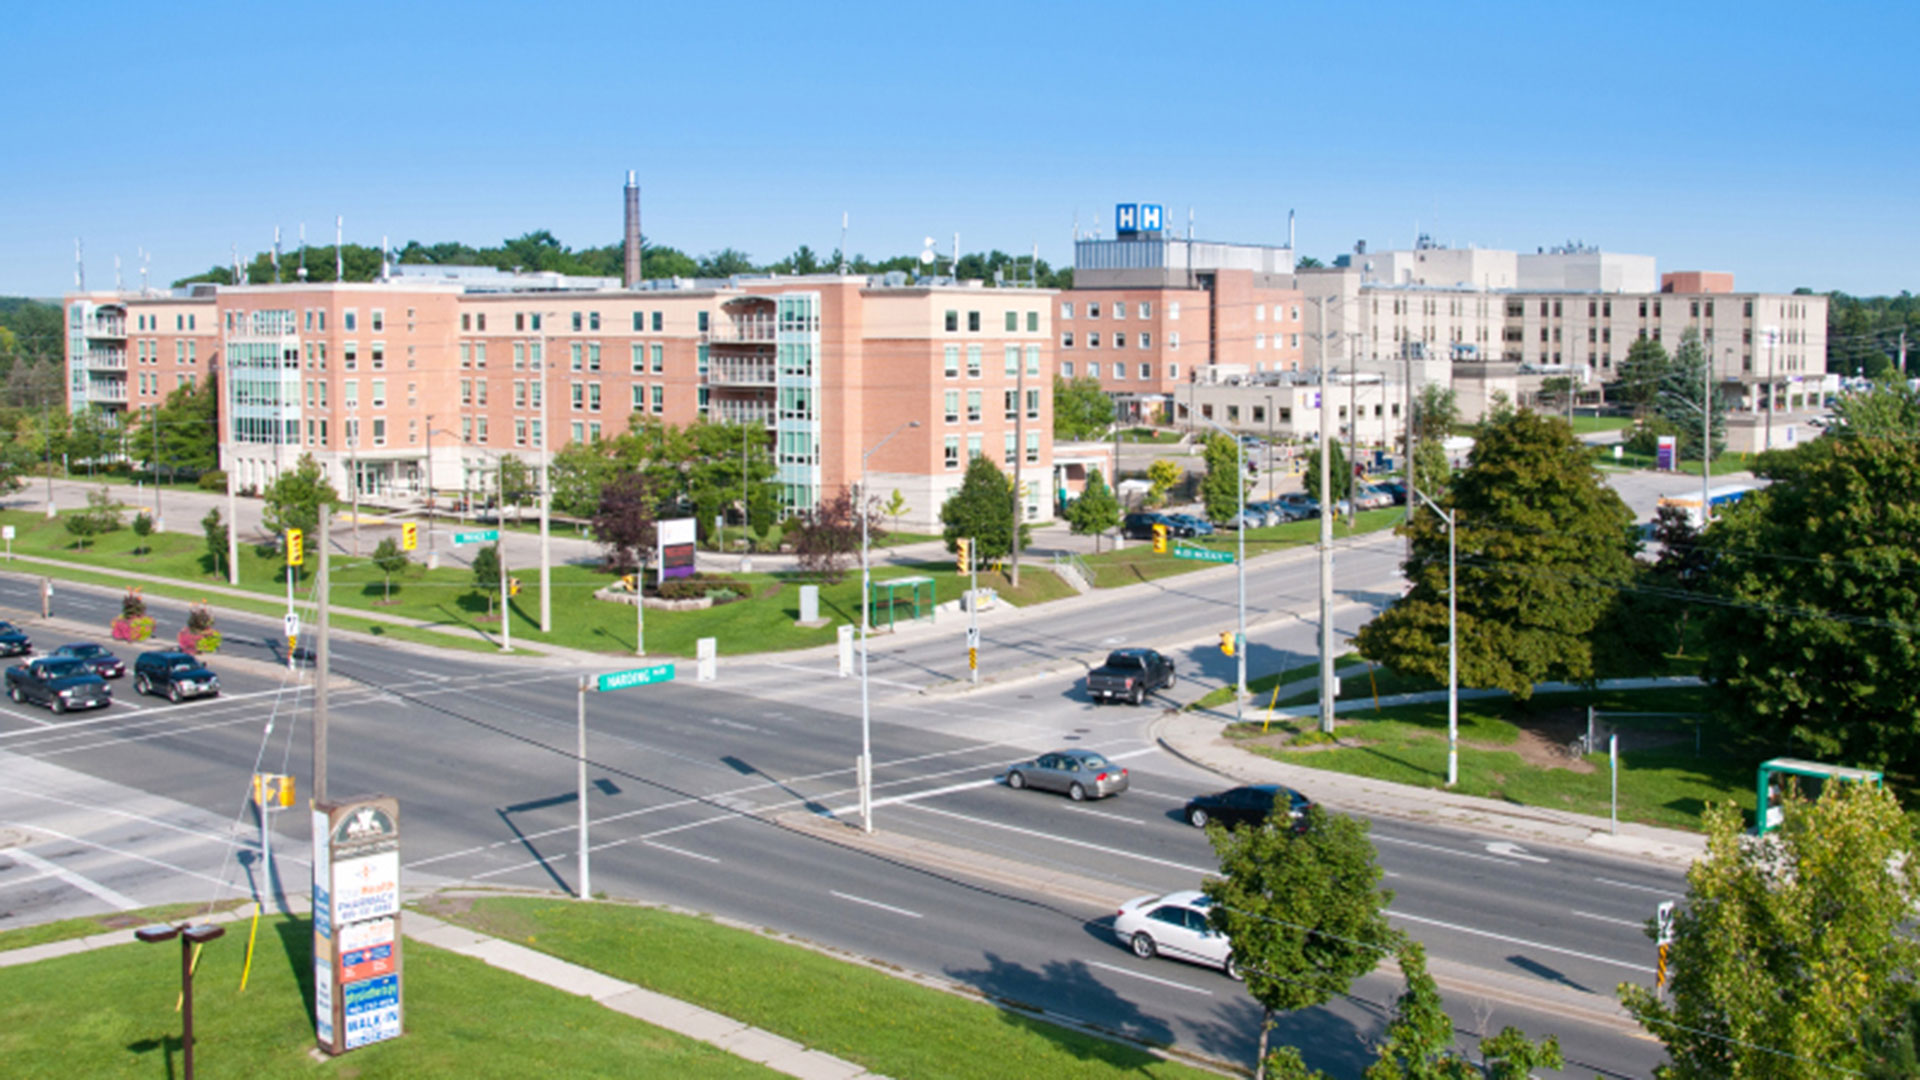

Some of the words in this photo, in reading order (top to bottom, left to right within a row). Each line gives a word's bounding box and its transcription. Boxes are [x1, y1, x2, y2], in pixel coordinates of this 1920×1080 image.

[1120, 207, 1134, 228] H
[1144, 207, 1160, 228] H
[606, 669, 650, 688] HARDING
[338, 892, 394, 911] PHARMACY
